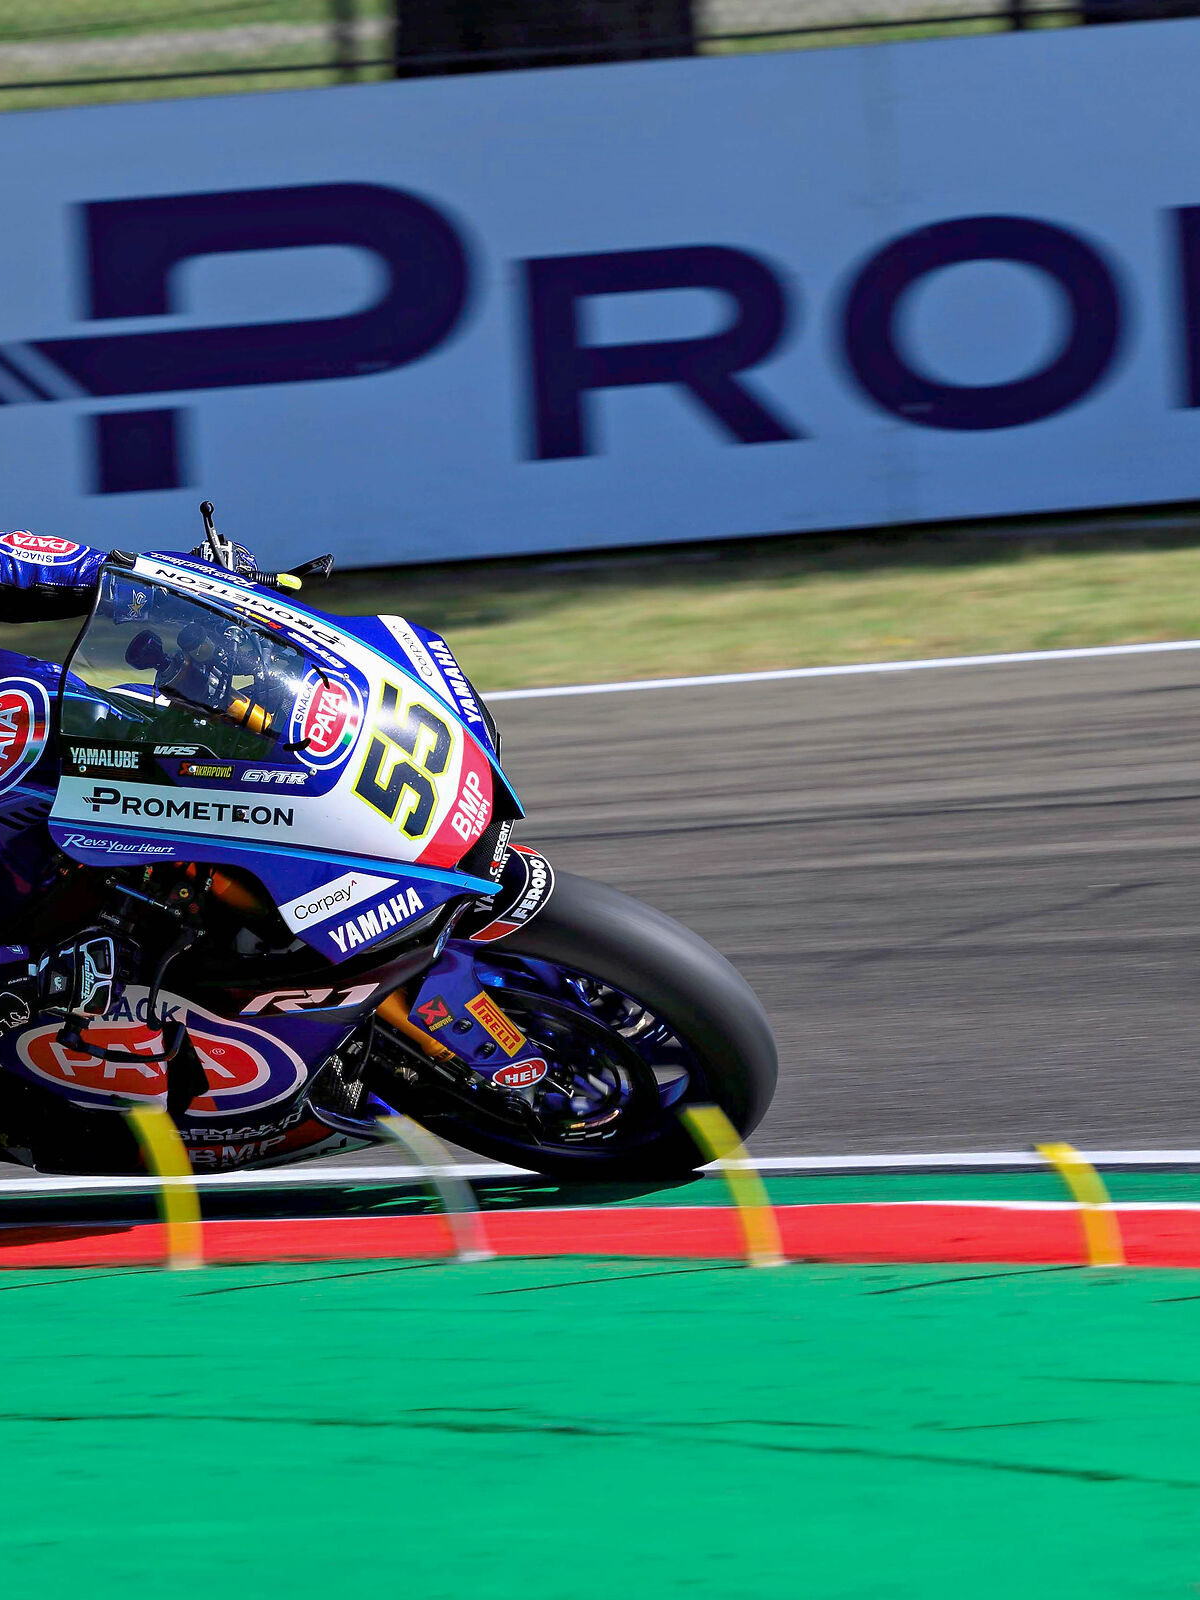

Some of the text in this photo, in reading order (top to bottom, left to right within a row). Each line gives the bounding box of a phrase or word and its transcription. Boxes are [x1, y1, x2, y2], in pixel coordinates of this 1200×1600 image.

[13, 532, 69, 551] PATA
[14, 549, 54, 564] SNACK
[155, 569, 345, 647] PROMETEON
[427, 640, 482, 723] YAMAHA
[296, 680, 315, 724] SNACK
[307, 691, 345, 748] PATA
[70, 747, 141, 769] YAMALUBE
[153, 745, 199, 756] WRS
[351, 677, 457, 842] 55
[241, 769, 308, 785] GYTR
[82, 786, 294, 826] PROMETEON
[451, 772, 485, 841] BMP
[471, 800, 490, 838] TAPPI
[294, 885, 351, 920] Corpay
[511, 857, 547, 919] FERODO
[328, 887, 424, 953] YAMAHA
[239, 983, 380, 1015] R1
[472, 998, 520, 1050] PIRELLI
[505, 1068, 541, 1083] HEL
[189, 1135, 286, 1163] BMP
